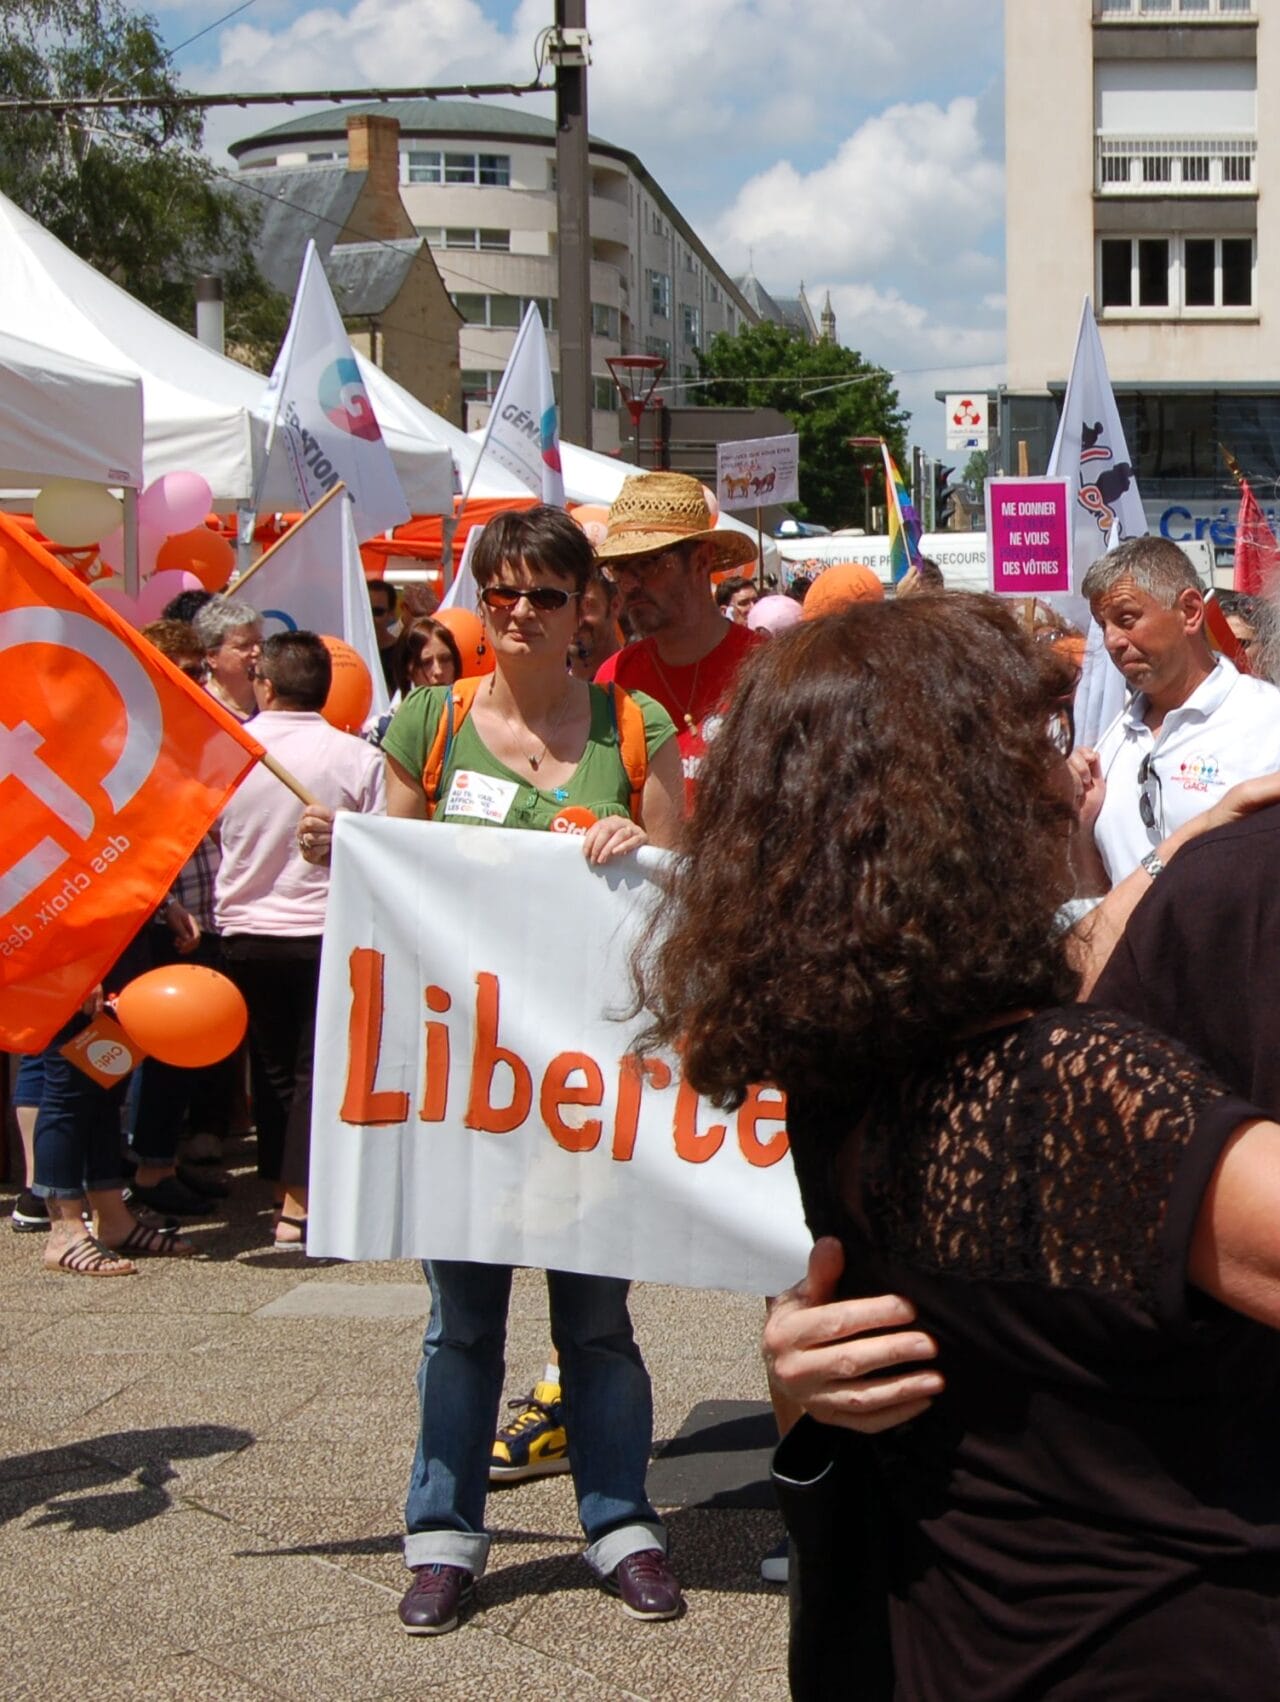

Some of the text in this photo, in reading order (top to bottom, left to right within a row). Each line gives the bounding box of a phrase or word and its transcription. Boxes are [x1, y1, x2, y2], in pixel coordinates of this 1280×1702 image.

[501, 404, 541, 441] GÉN
[1001, 502, 1056, 516] ME DONNER
[1009, 531, 1050, 546] NE VOUS
[936, 552, 986, 565] SECOURS
[1002, 558, 1059, 576] DES VÔTRES
